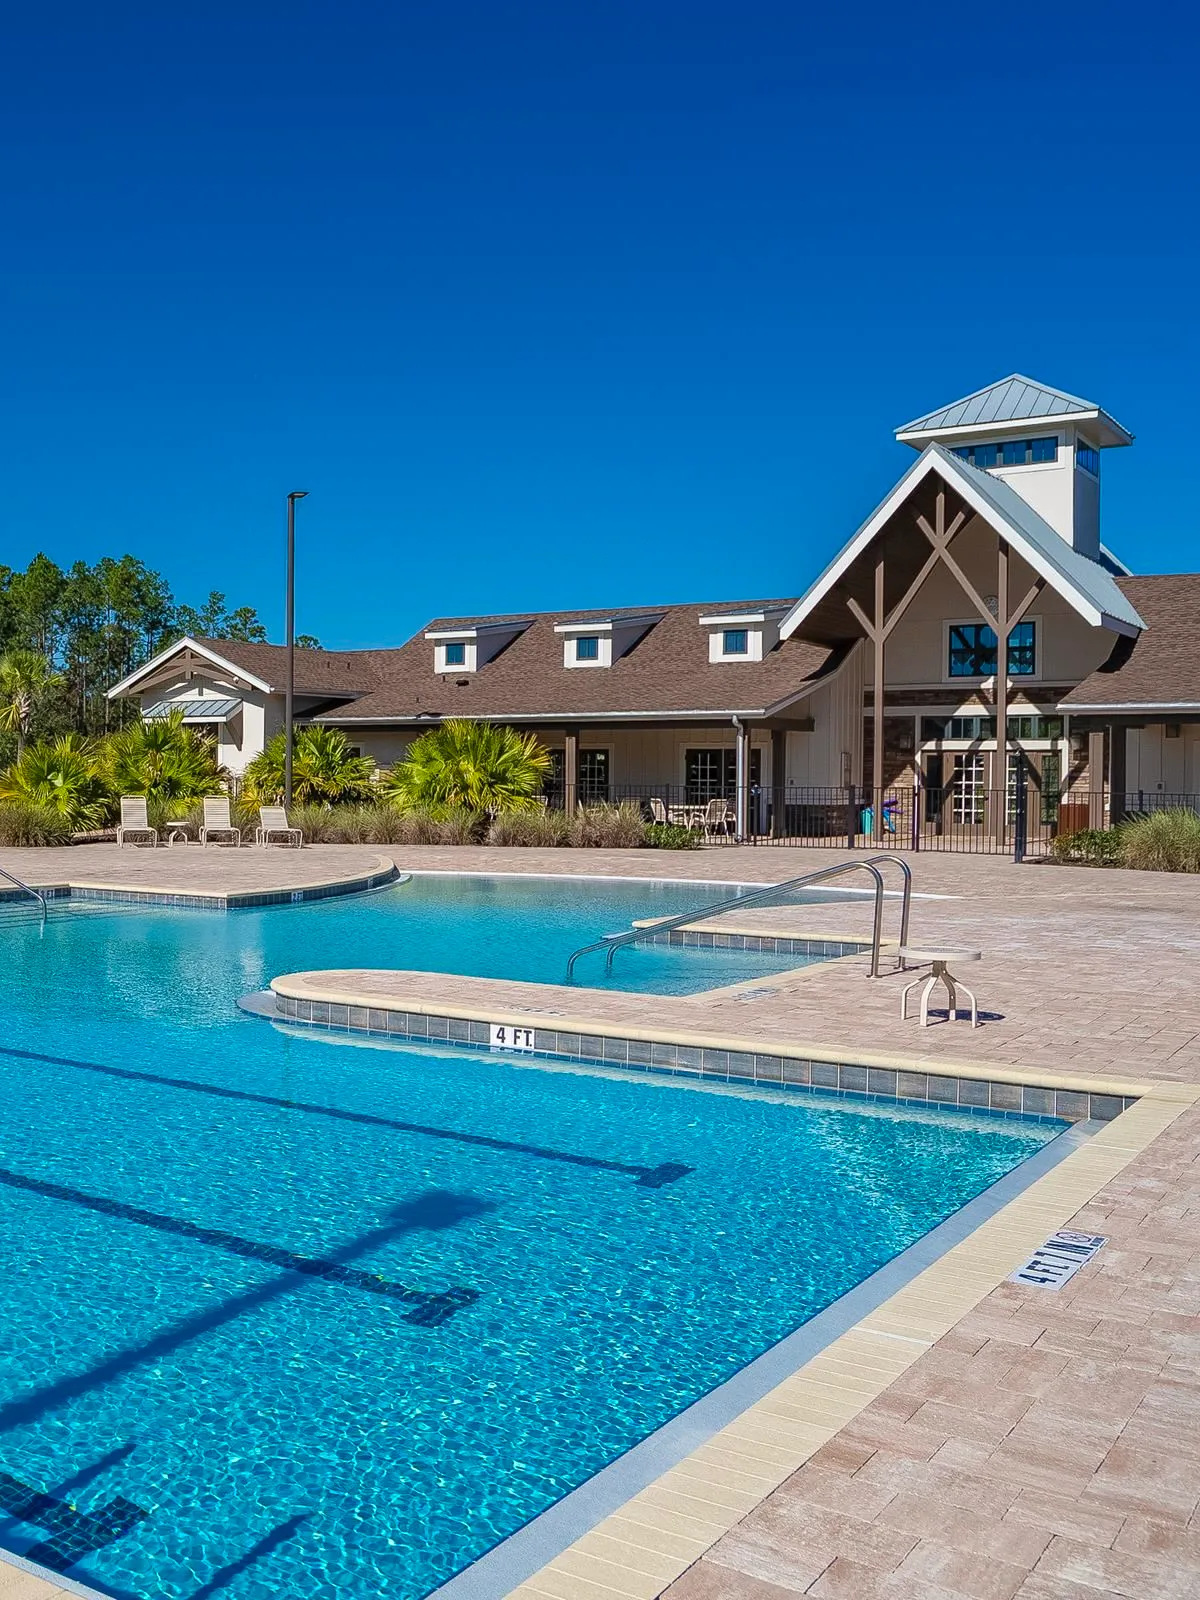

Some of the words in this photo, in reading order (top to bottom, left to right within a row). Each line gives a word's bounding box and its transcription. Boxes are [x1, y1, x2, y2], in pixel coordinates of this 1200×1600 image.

[496, 1027, 506, 1043] 4
[513, 1029, 532, 1047] FT.
[1033, 1251, 1082, 1263] 7
[1018, 1273, 1056, 1283] 4
